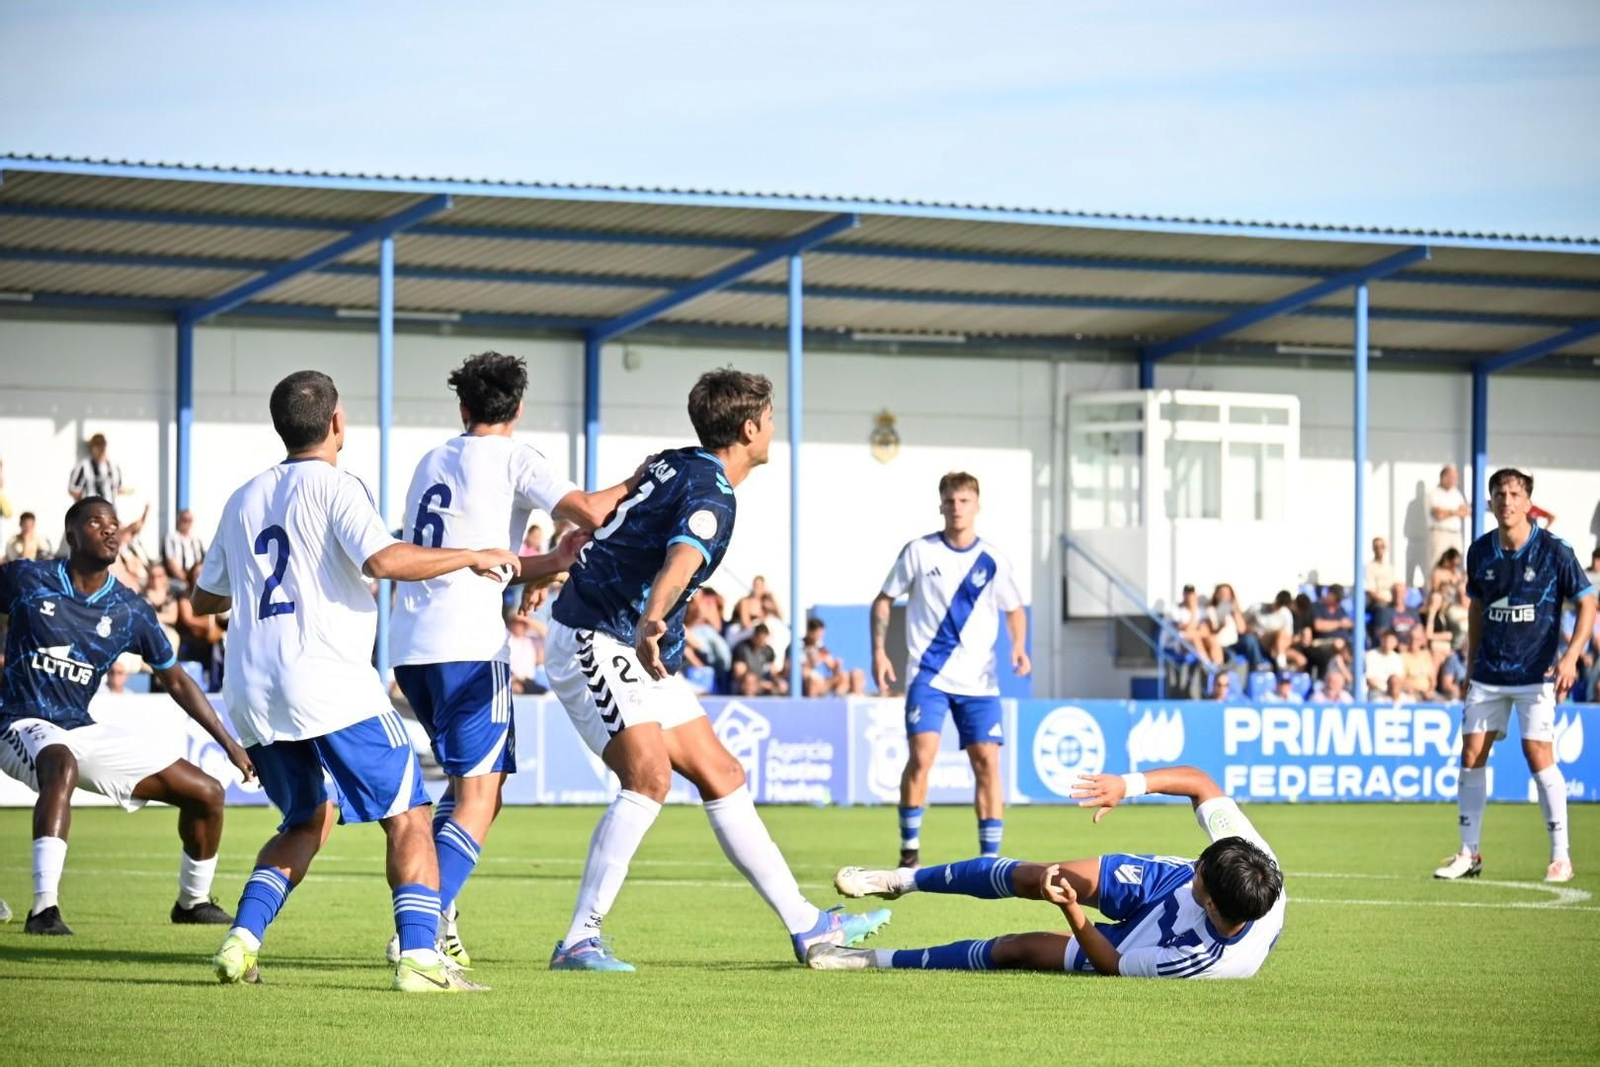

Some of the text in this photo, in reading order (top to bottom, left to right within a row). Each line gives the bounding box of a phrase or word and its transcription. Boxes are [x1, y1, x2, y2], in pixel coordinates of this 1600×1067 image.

[413, 483, 452, 548] 6
[254, 524, 295, 620] 2
[1488, 608, 1535, 623] LOTUS
[31, 652, 93, 686] LOTUS
[1224, 757, 1494, 798] FEDERACIÓ
